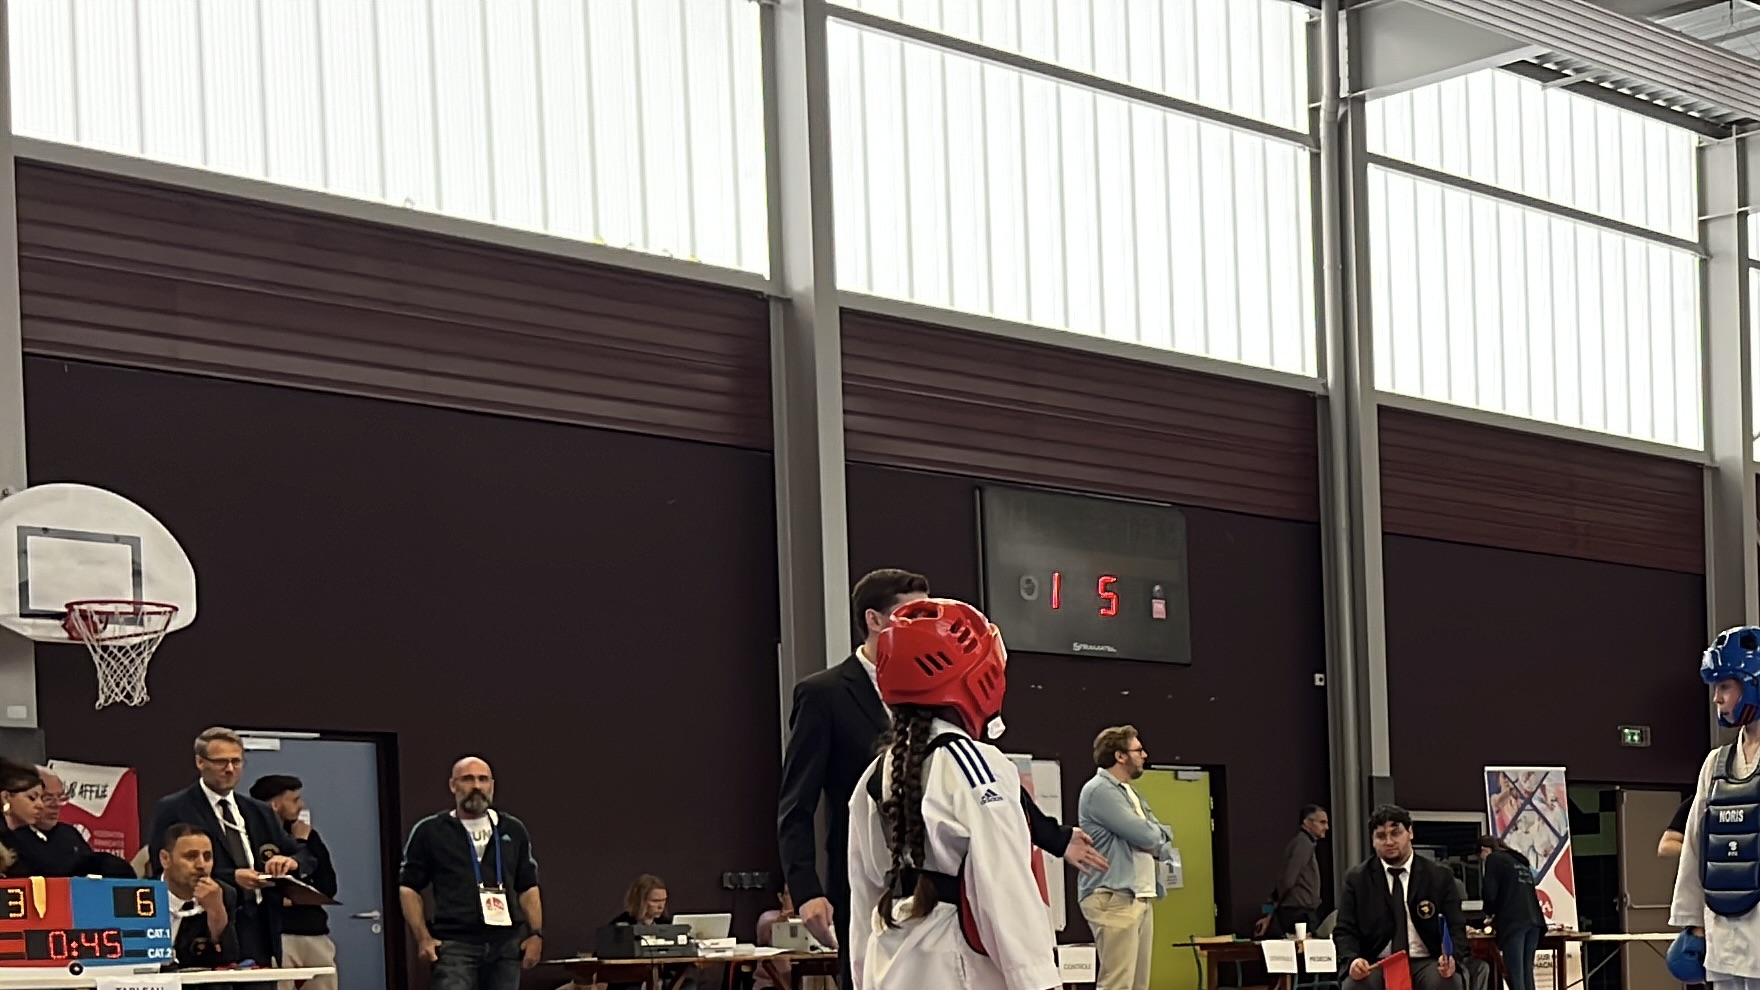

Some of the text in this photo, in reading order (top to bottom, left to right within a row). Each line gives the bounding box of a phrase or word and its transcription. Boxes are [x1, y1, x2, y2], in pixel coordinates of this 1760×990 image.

[1099, 575, 1119, 617] 5
[1719, 809, 1744, 823] NORIS
[8, 888, 155, 918] 3 6
[49, 928, 171, 959] 0:45 CAT.1
